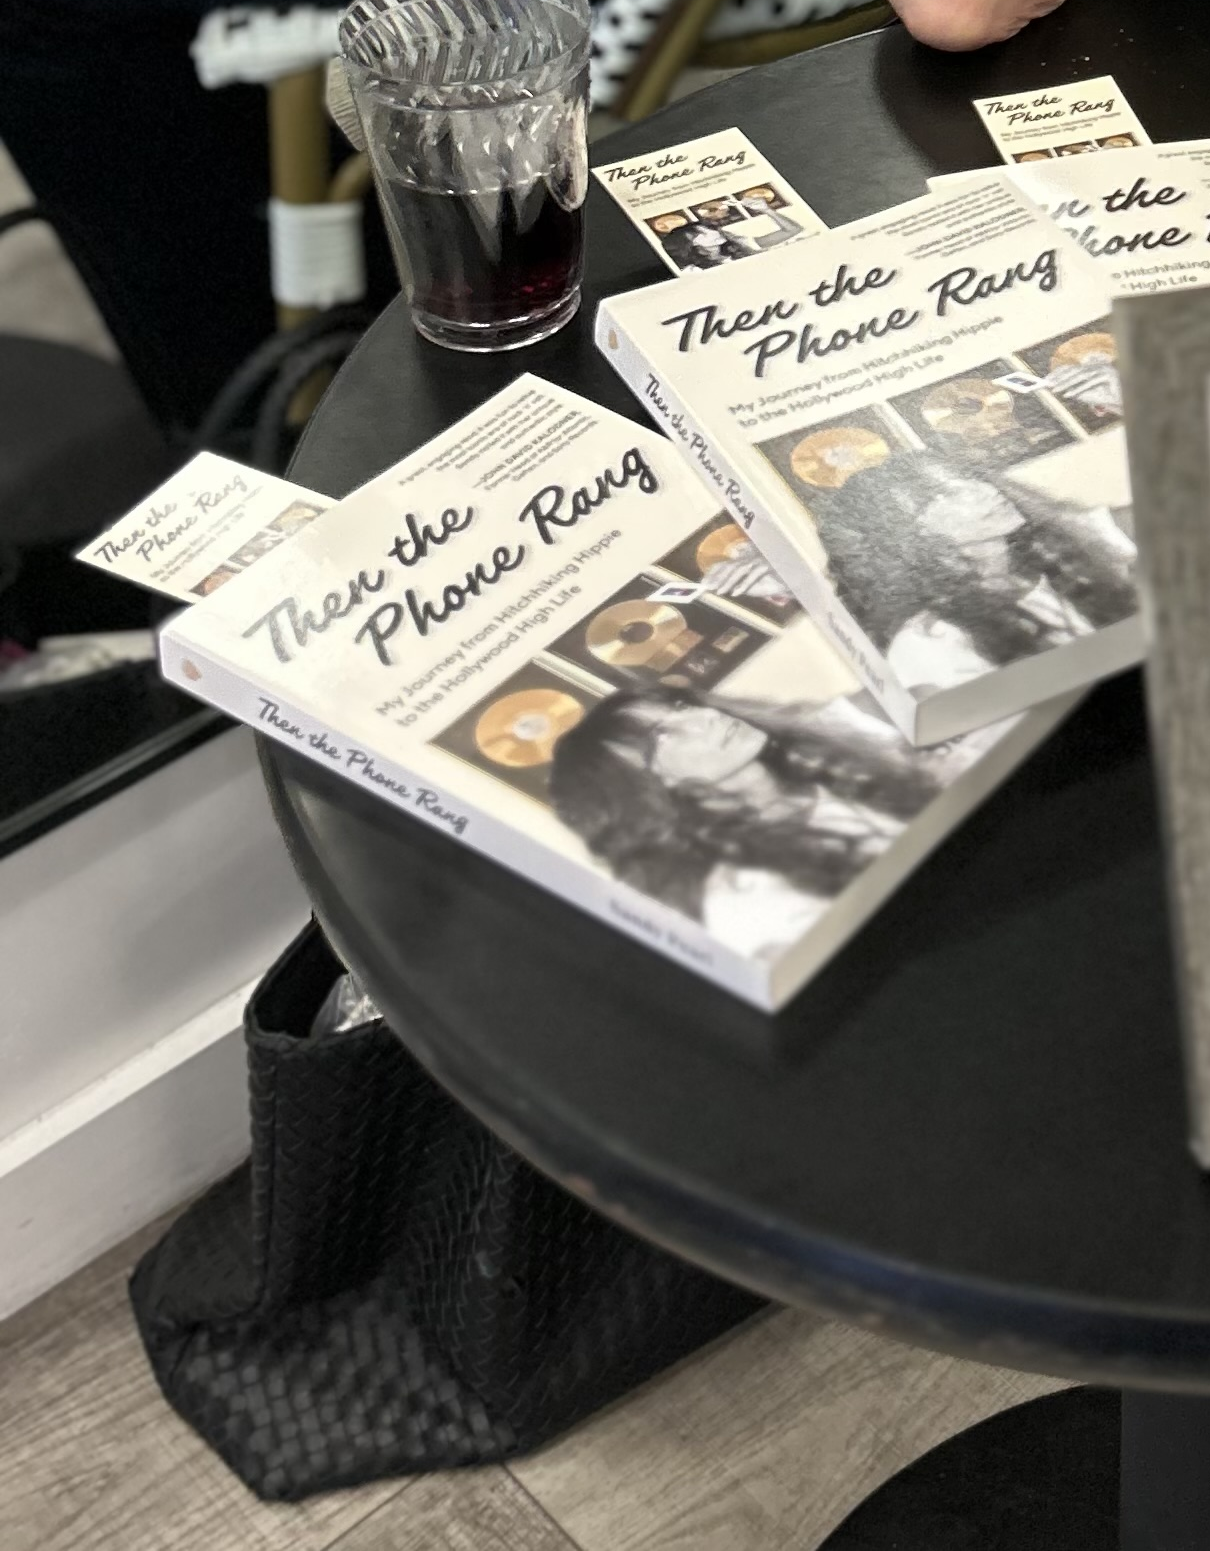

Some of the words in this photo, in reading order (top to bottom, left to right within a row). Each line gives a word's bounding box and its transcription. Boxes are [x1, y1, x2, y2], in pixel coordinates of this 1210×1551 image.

[984, 102, 1028, 115] Then
[1032, 95, 1062, 107] the
[1007, 111, 1064, 126] Phone
[1070, 99, 1115, 114] Rang
[604, 166, 652, 182] Then
[655, 153, 688, 168] the
[630, 169, 694, 190] Phone
[698, 151, 746, 172] Rang
[1102, 177, 1187, 213] the
[661, 299, 800, 352] Then
[809, 264, 898, 306] the
[1124, 258, 1210, 278] Hitchhiking
[1130, 277, 1167, 291] High
[1170, 276, 1198, 286] Life
[744, 306, 919, 378] Phone
[928, 248, 1060, 316] Rang
[728, 402, 755, 415] My
[759, 380, 823, 406] Journey
[821, 366, 862, 384] from
[862, 335, 953, 370] Hitchhiking
[952, 315, 1003, 340] Hippie
[738, 416, 758, 428] to
[759, 407, 788, 423] the
[788, 379, 873, 412] Hollywood
[873, 364, 914, 384] High
[914, 353, 945, 369] Life
[645, 373, 670, 417] Then
[671, 414, 689, 441] the
[690, 432, 724, 486] Phone
[725, 478, 755, 529] Rang
[242, 569, 385, 663] Then
[388, 506, 474, 567] the
[354, 545, 525, 666] Phone
[519, 447, 658, 544] Rang
[376, 695, 406, 716] My
[403, 648, 465, 695] Journey
[460, 621, 497, 651] from
[493, 563, 580, 624] Hitchhiking
[572, 529, 622, 564] Hippie
[396, 711, 418, 728] to
[416, 690, 445, 717] the
[442, 632, 519, 692] Hollywood
[518, 605, 556, 634] High
[551, 584, 582, 607] Life
[259, 697, 305, 739] Then
[308, 733, 342, 760] the
[346, 749, 412, 798] Phone
[415, 787, 468, 835] Rang
